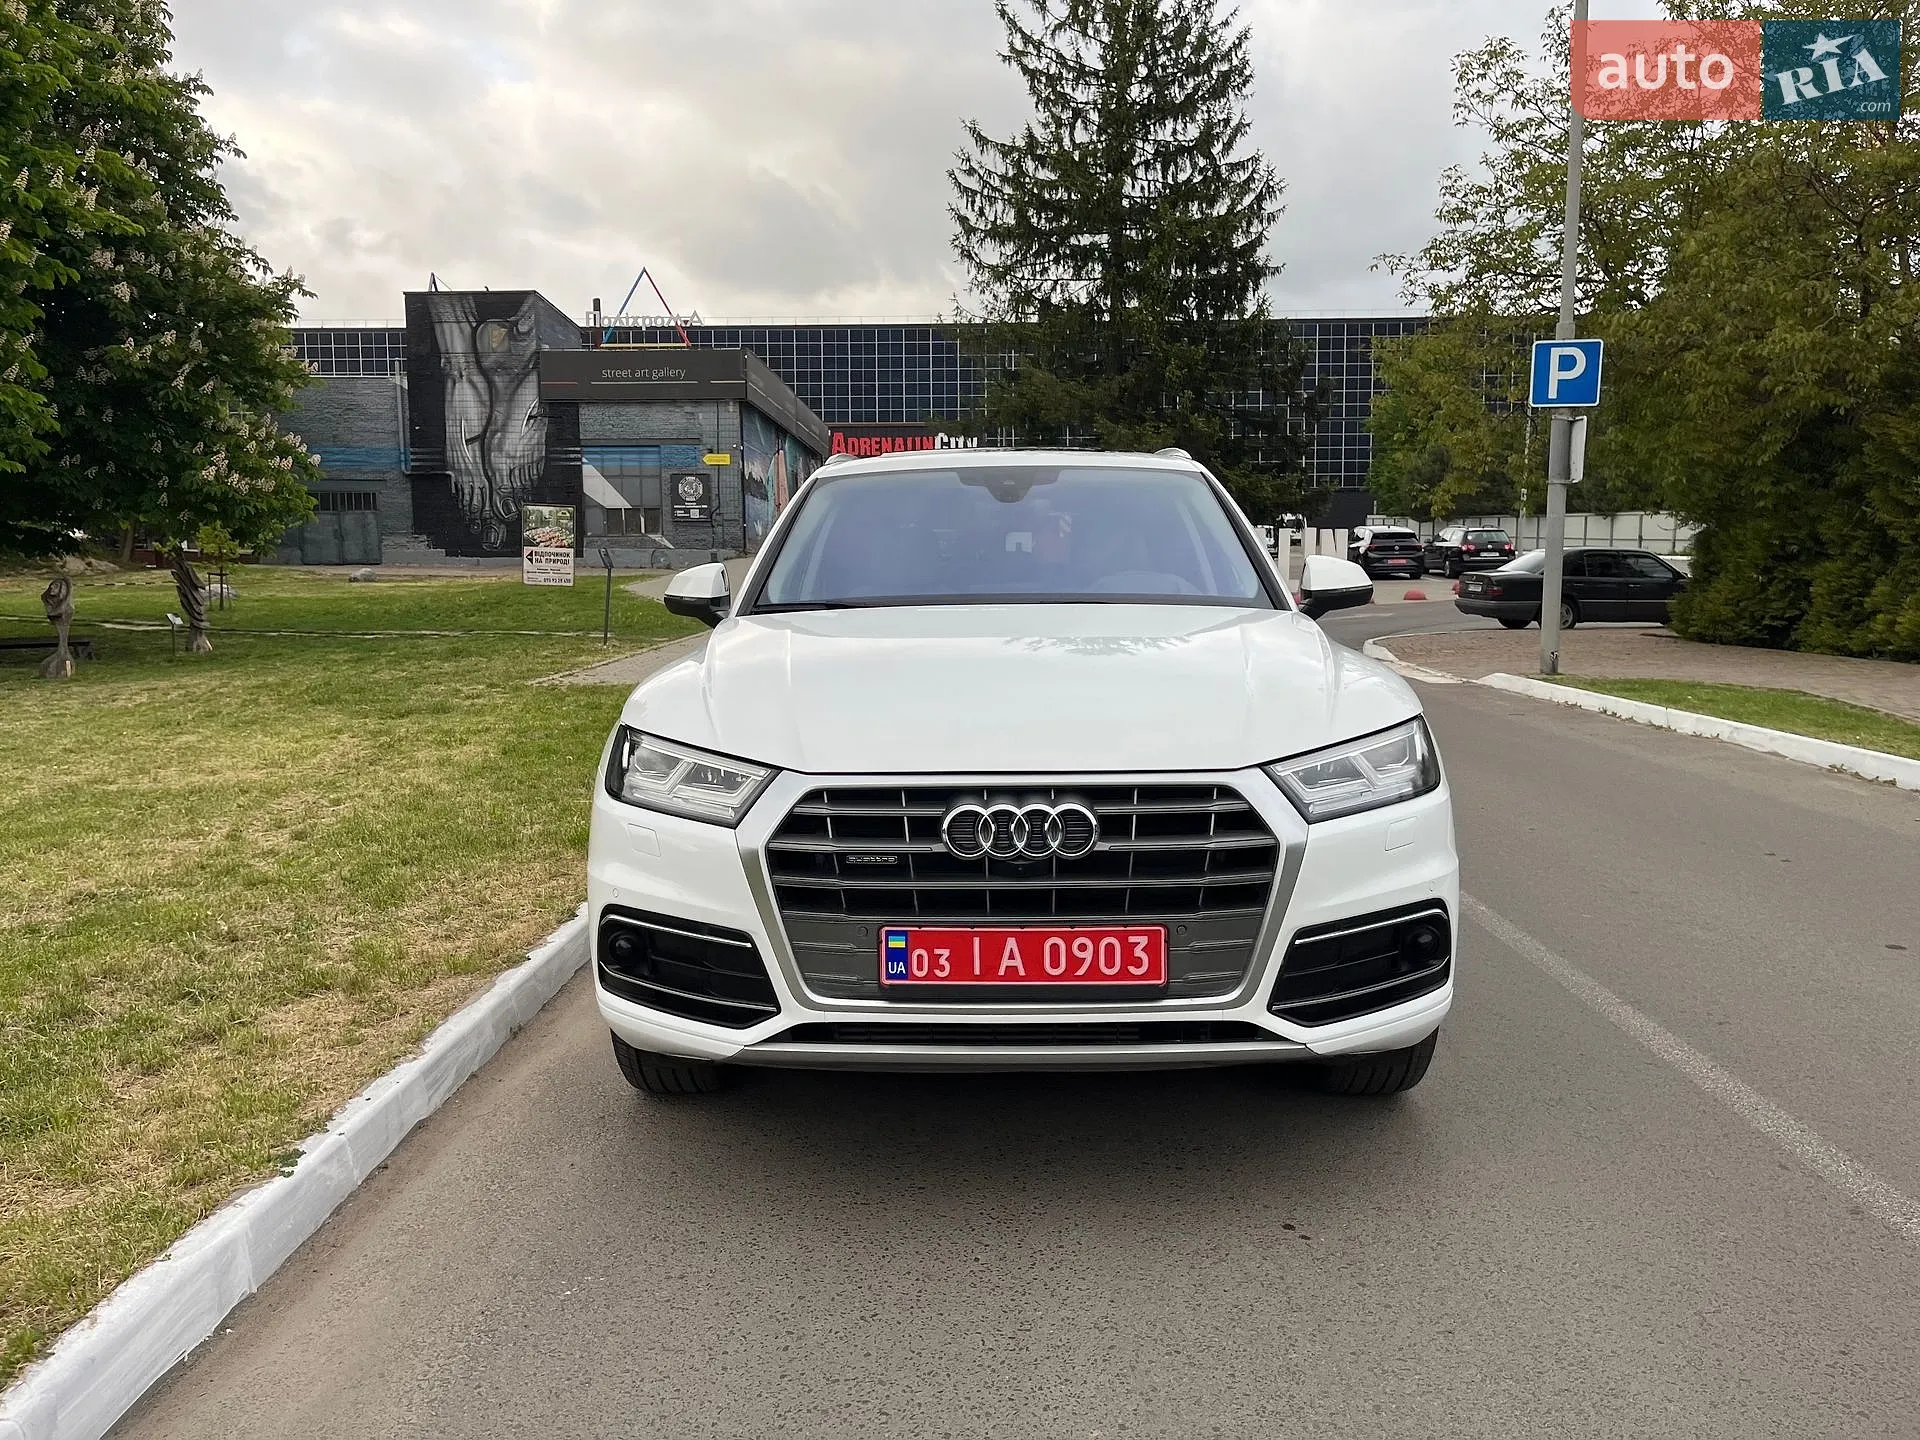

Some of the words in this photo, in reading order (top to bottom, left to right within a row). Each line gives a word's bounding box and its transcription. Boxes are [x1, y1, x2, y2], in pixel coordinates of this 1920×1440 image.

[601, 368, 632, 378] street
[634, 368, 650, 378] art
[651, 367, 686, 380] gallery
[1548, 346, 1587, 399] P
[888, 962, 906, 974] UA
[911, 948, 950, 978] 03
[1043, 935, 1149, 976] 0903
